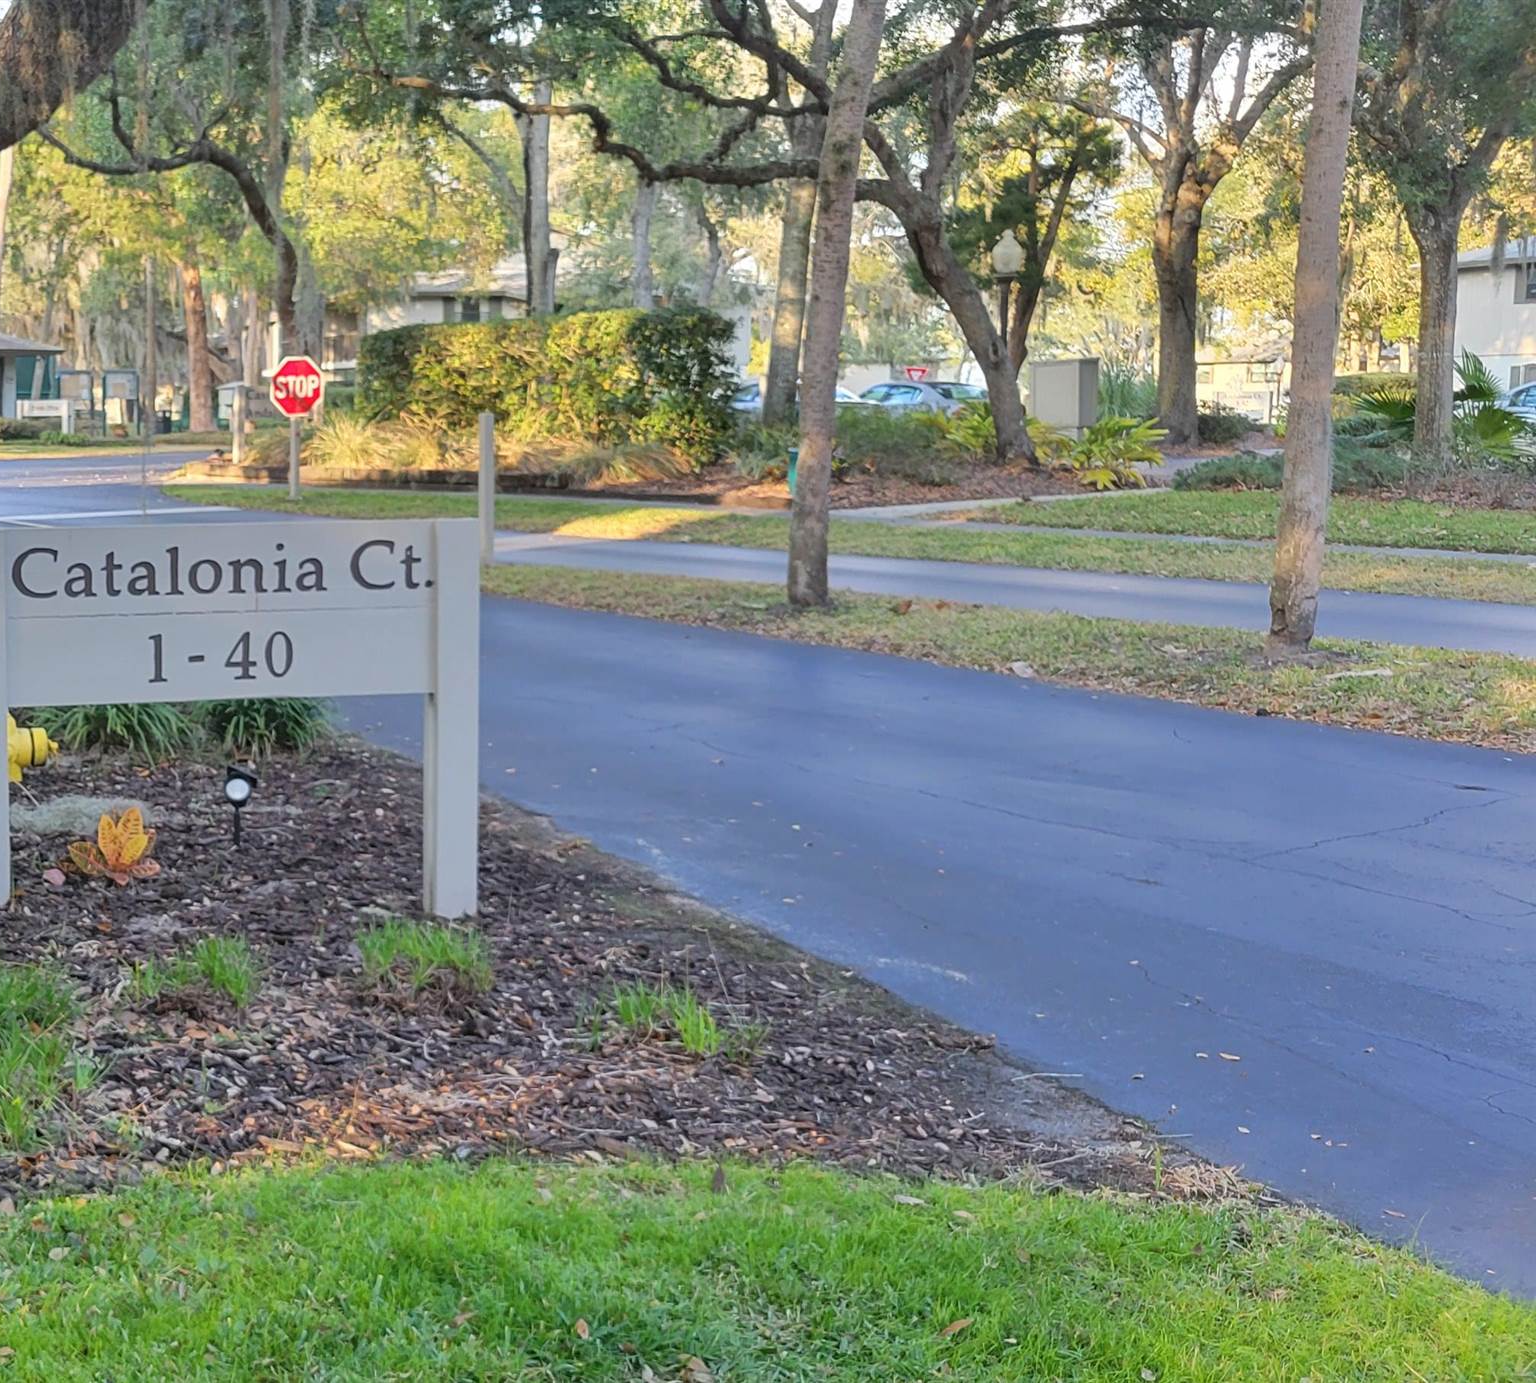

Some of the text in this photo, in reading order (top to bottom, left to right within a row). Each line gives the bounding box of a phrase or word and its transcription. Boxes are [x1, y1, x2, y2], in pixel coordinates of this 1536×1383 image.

[275, 374, 319, 399] STOP
[11, 538, 435, 599] Catalonia Ct.
